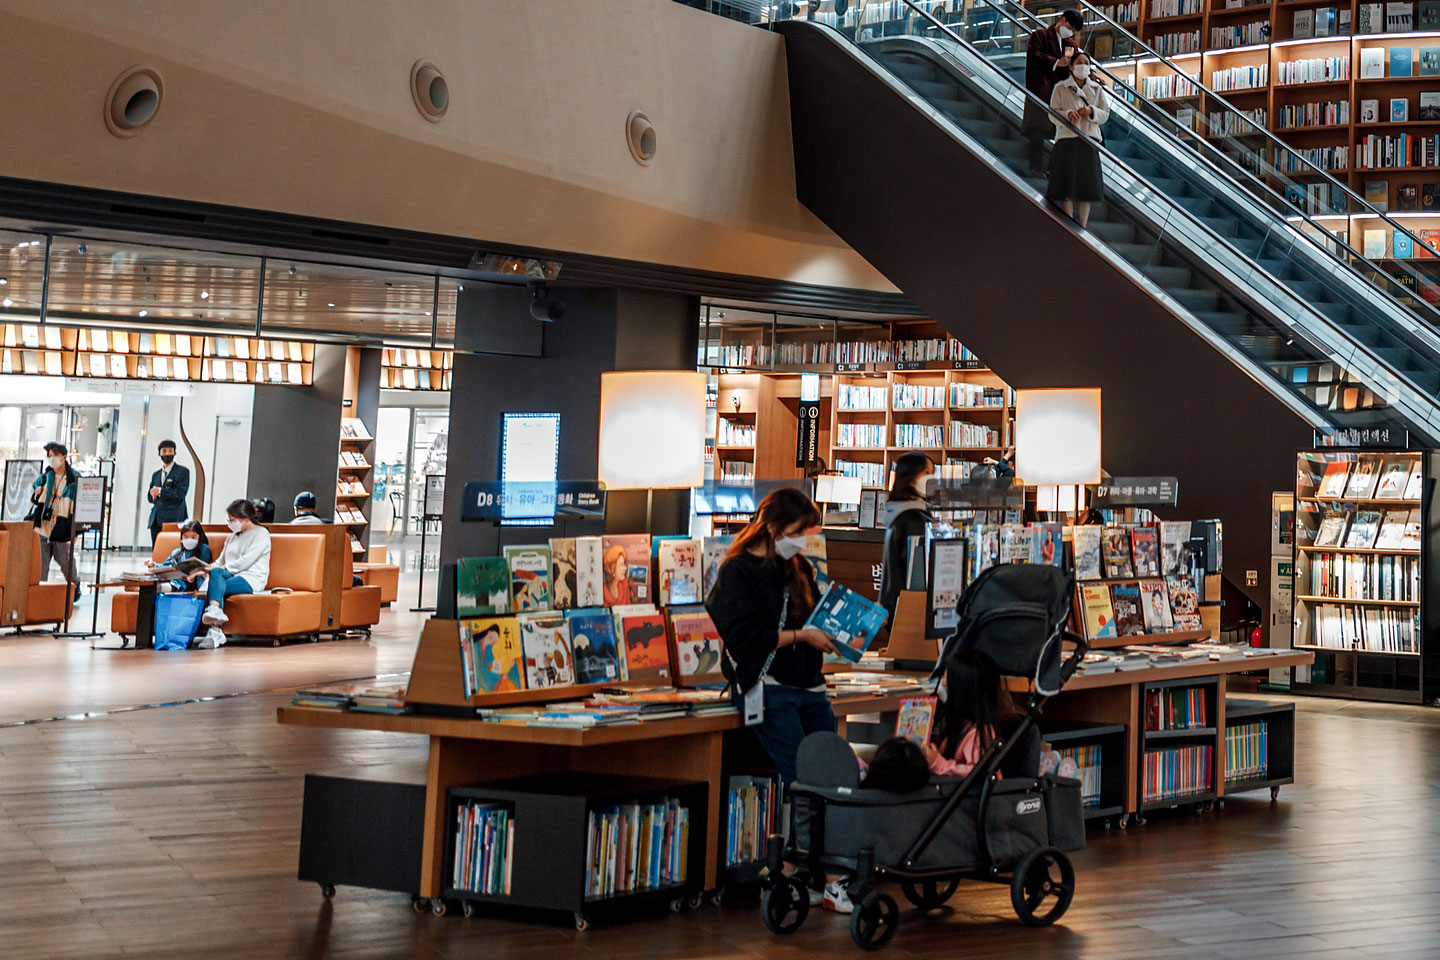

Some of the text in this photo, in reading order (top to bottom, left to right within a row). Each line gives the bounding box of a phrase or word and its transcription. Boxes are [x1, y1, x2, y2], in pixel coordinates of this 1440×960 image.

[808, 419, 816, 462] INFORMATION
[477, 492, 493, 507] D8
[1097, 486, 1108, 498] D7
